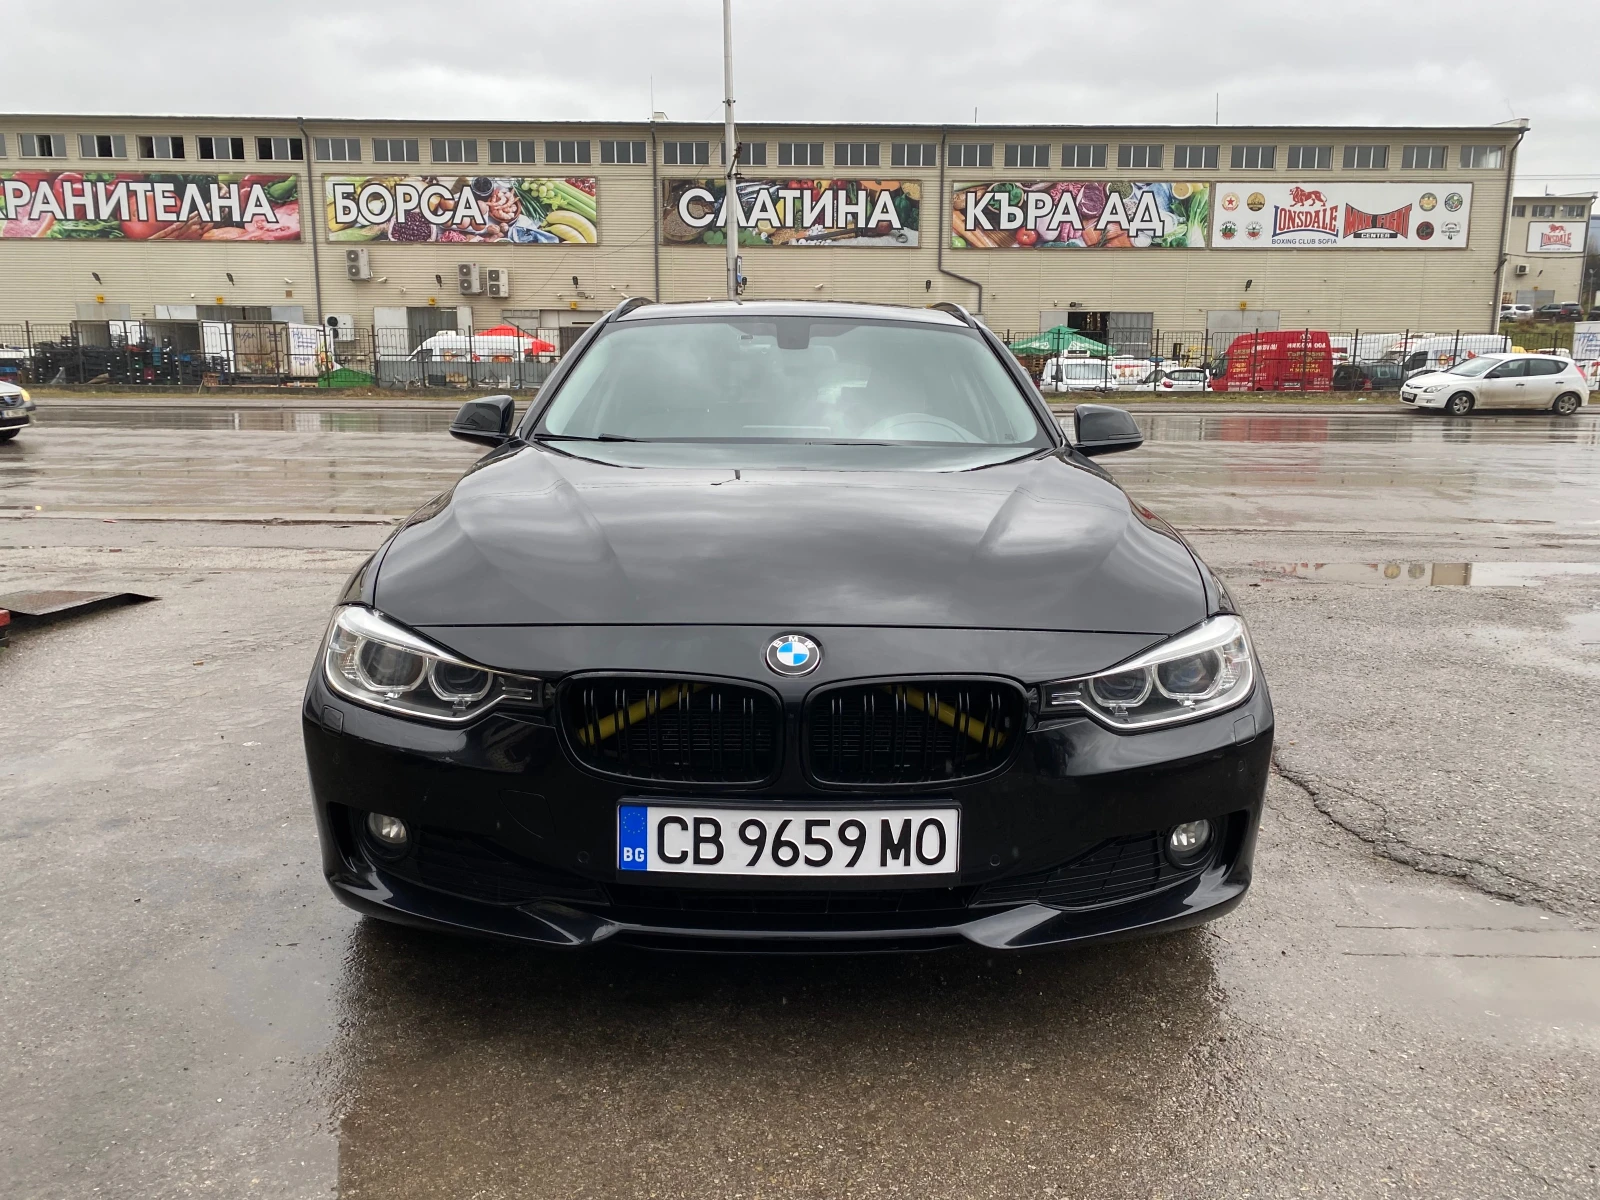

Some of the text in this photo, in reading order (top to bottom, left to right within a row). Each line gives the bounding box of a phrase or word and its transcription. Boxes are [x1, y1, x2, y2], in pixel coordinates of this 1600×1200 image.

[0, 179, 279, 223] РАНИТЕЛНА
[333, 183, 486, 225] БОРСА
[965, 191, 1165, 237] КЪРА АД
[1272, 205, 1339, 238] LONSDALE
[1376, 203, 1413, 240] FIGHT
[1540, 232, 1572, 247] LONSDALE
[772, 634, 815, 649] BMW
[623, 847, 645, 862] BG
[657, 815, 947, 868] CB 9659 MO
